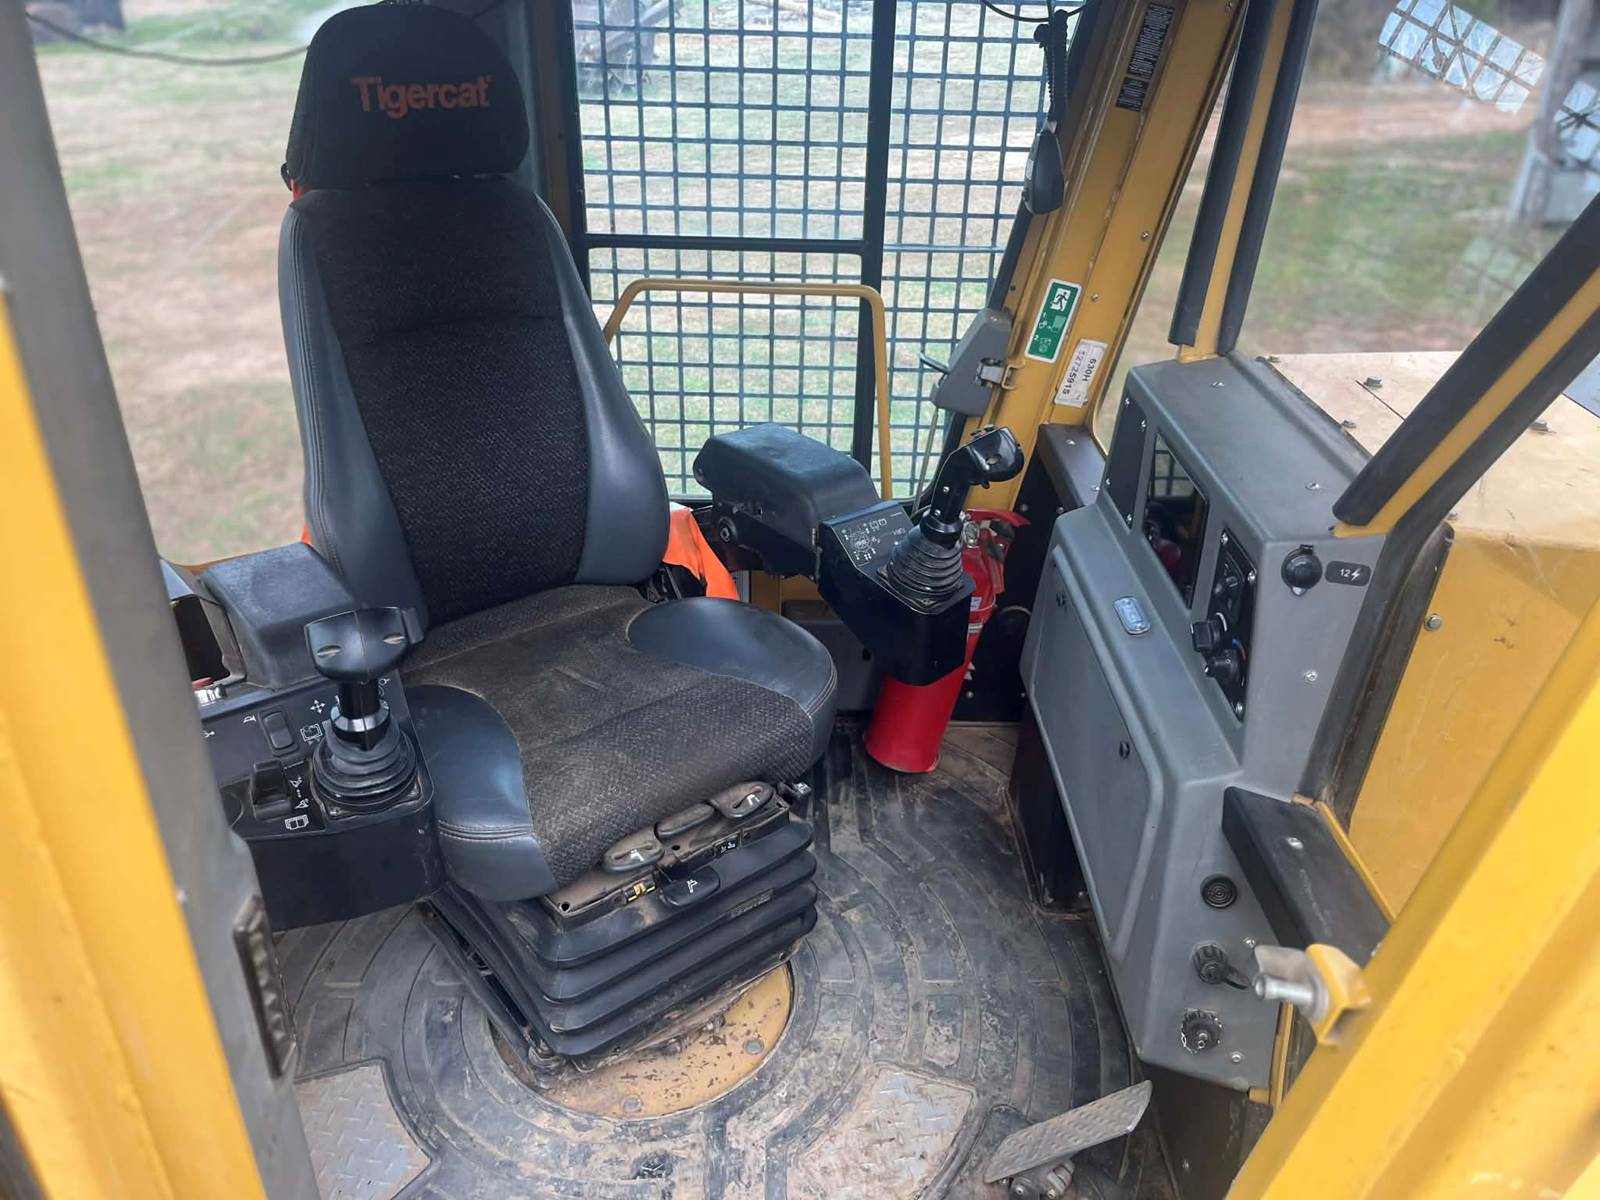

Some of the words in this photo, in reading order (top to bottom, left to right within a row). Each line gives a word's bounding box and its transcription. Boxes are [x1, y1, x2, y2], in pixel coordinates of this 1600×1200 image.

[350, 75, 490, 119] Tigercat
[1062, 351, 1086, 395] 2725915
[1081, 358, 1097, 382] 630H
[1340, 568, 1351, 578] 12
